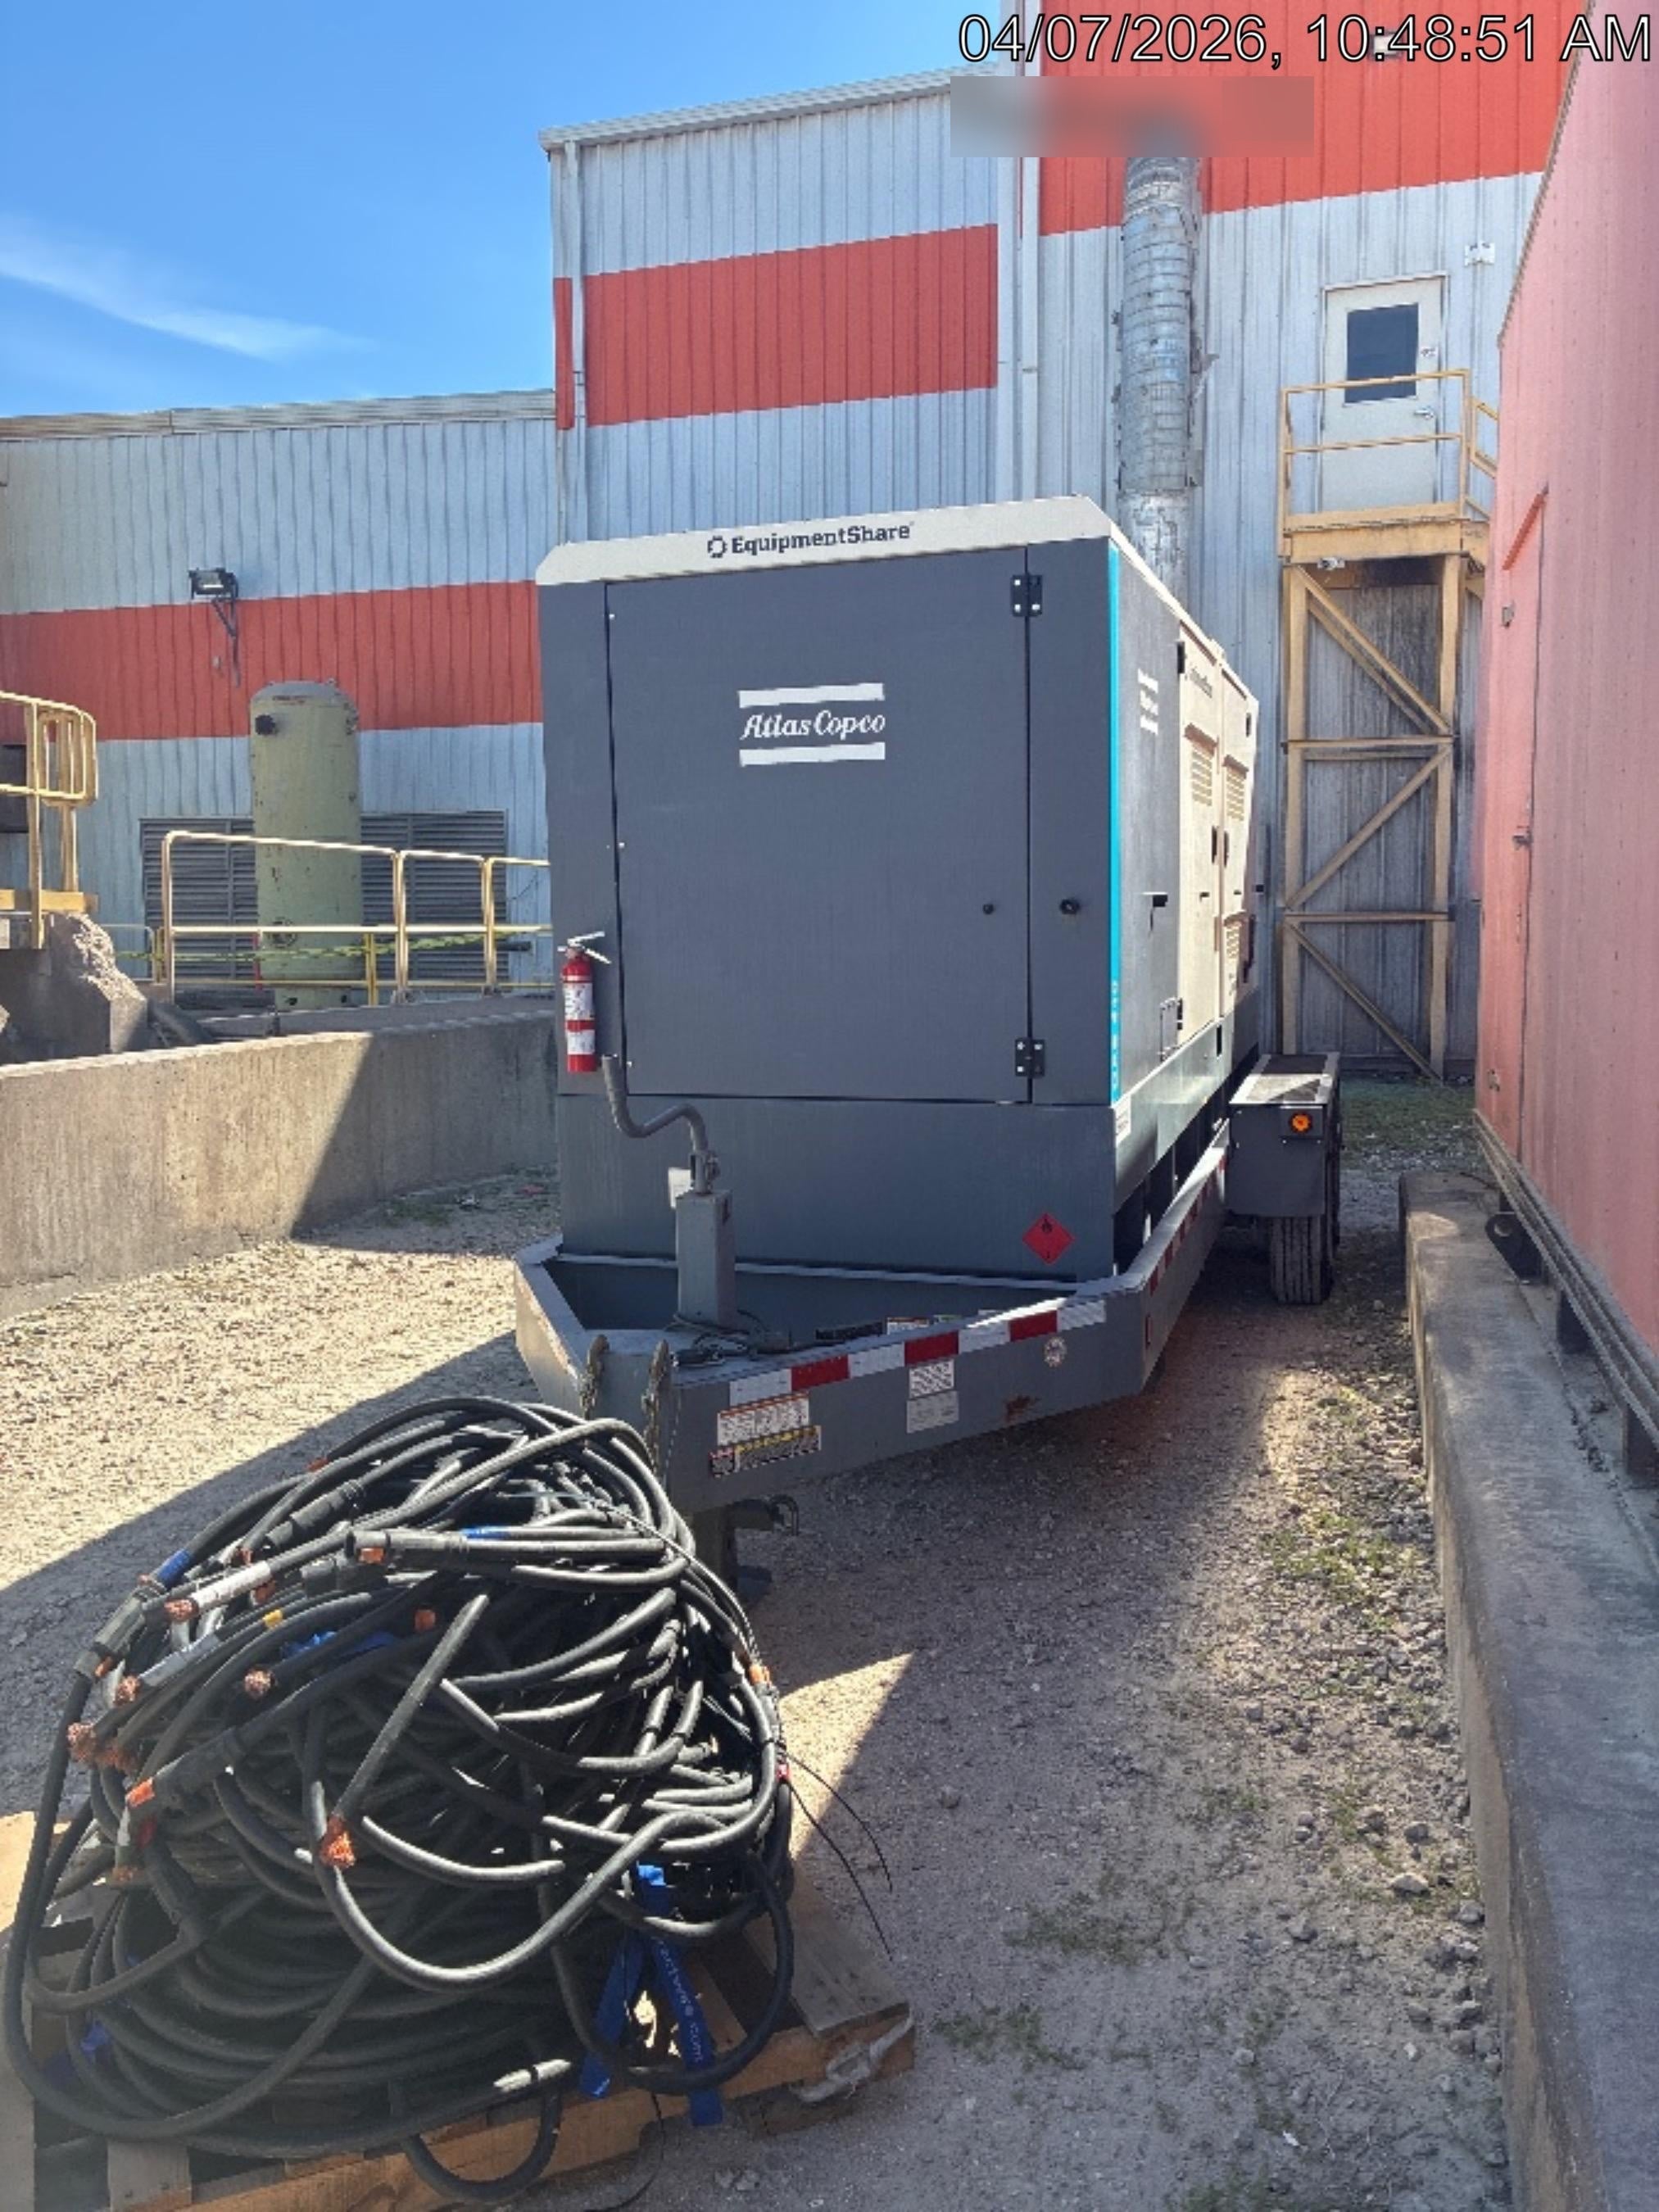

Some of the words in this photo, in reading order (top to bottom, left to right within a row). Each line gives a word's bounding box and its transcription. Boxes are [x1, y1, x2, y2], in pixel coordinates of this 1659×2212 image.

[732, 525, 910, 555] EquipmentShare
[740, 712, 812, 741] Atlas
[814, 709, 886, 741] Copco
